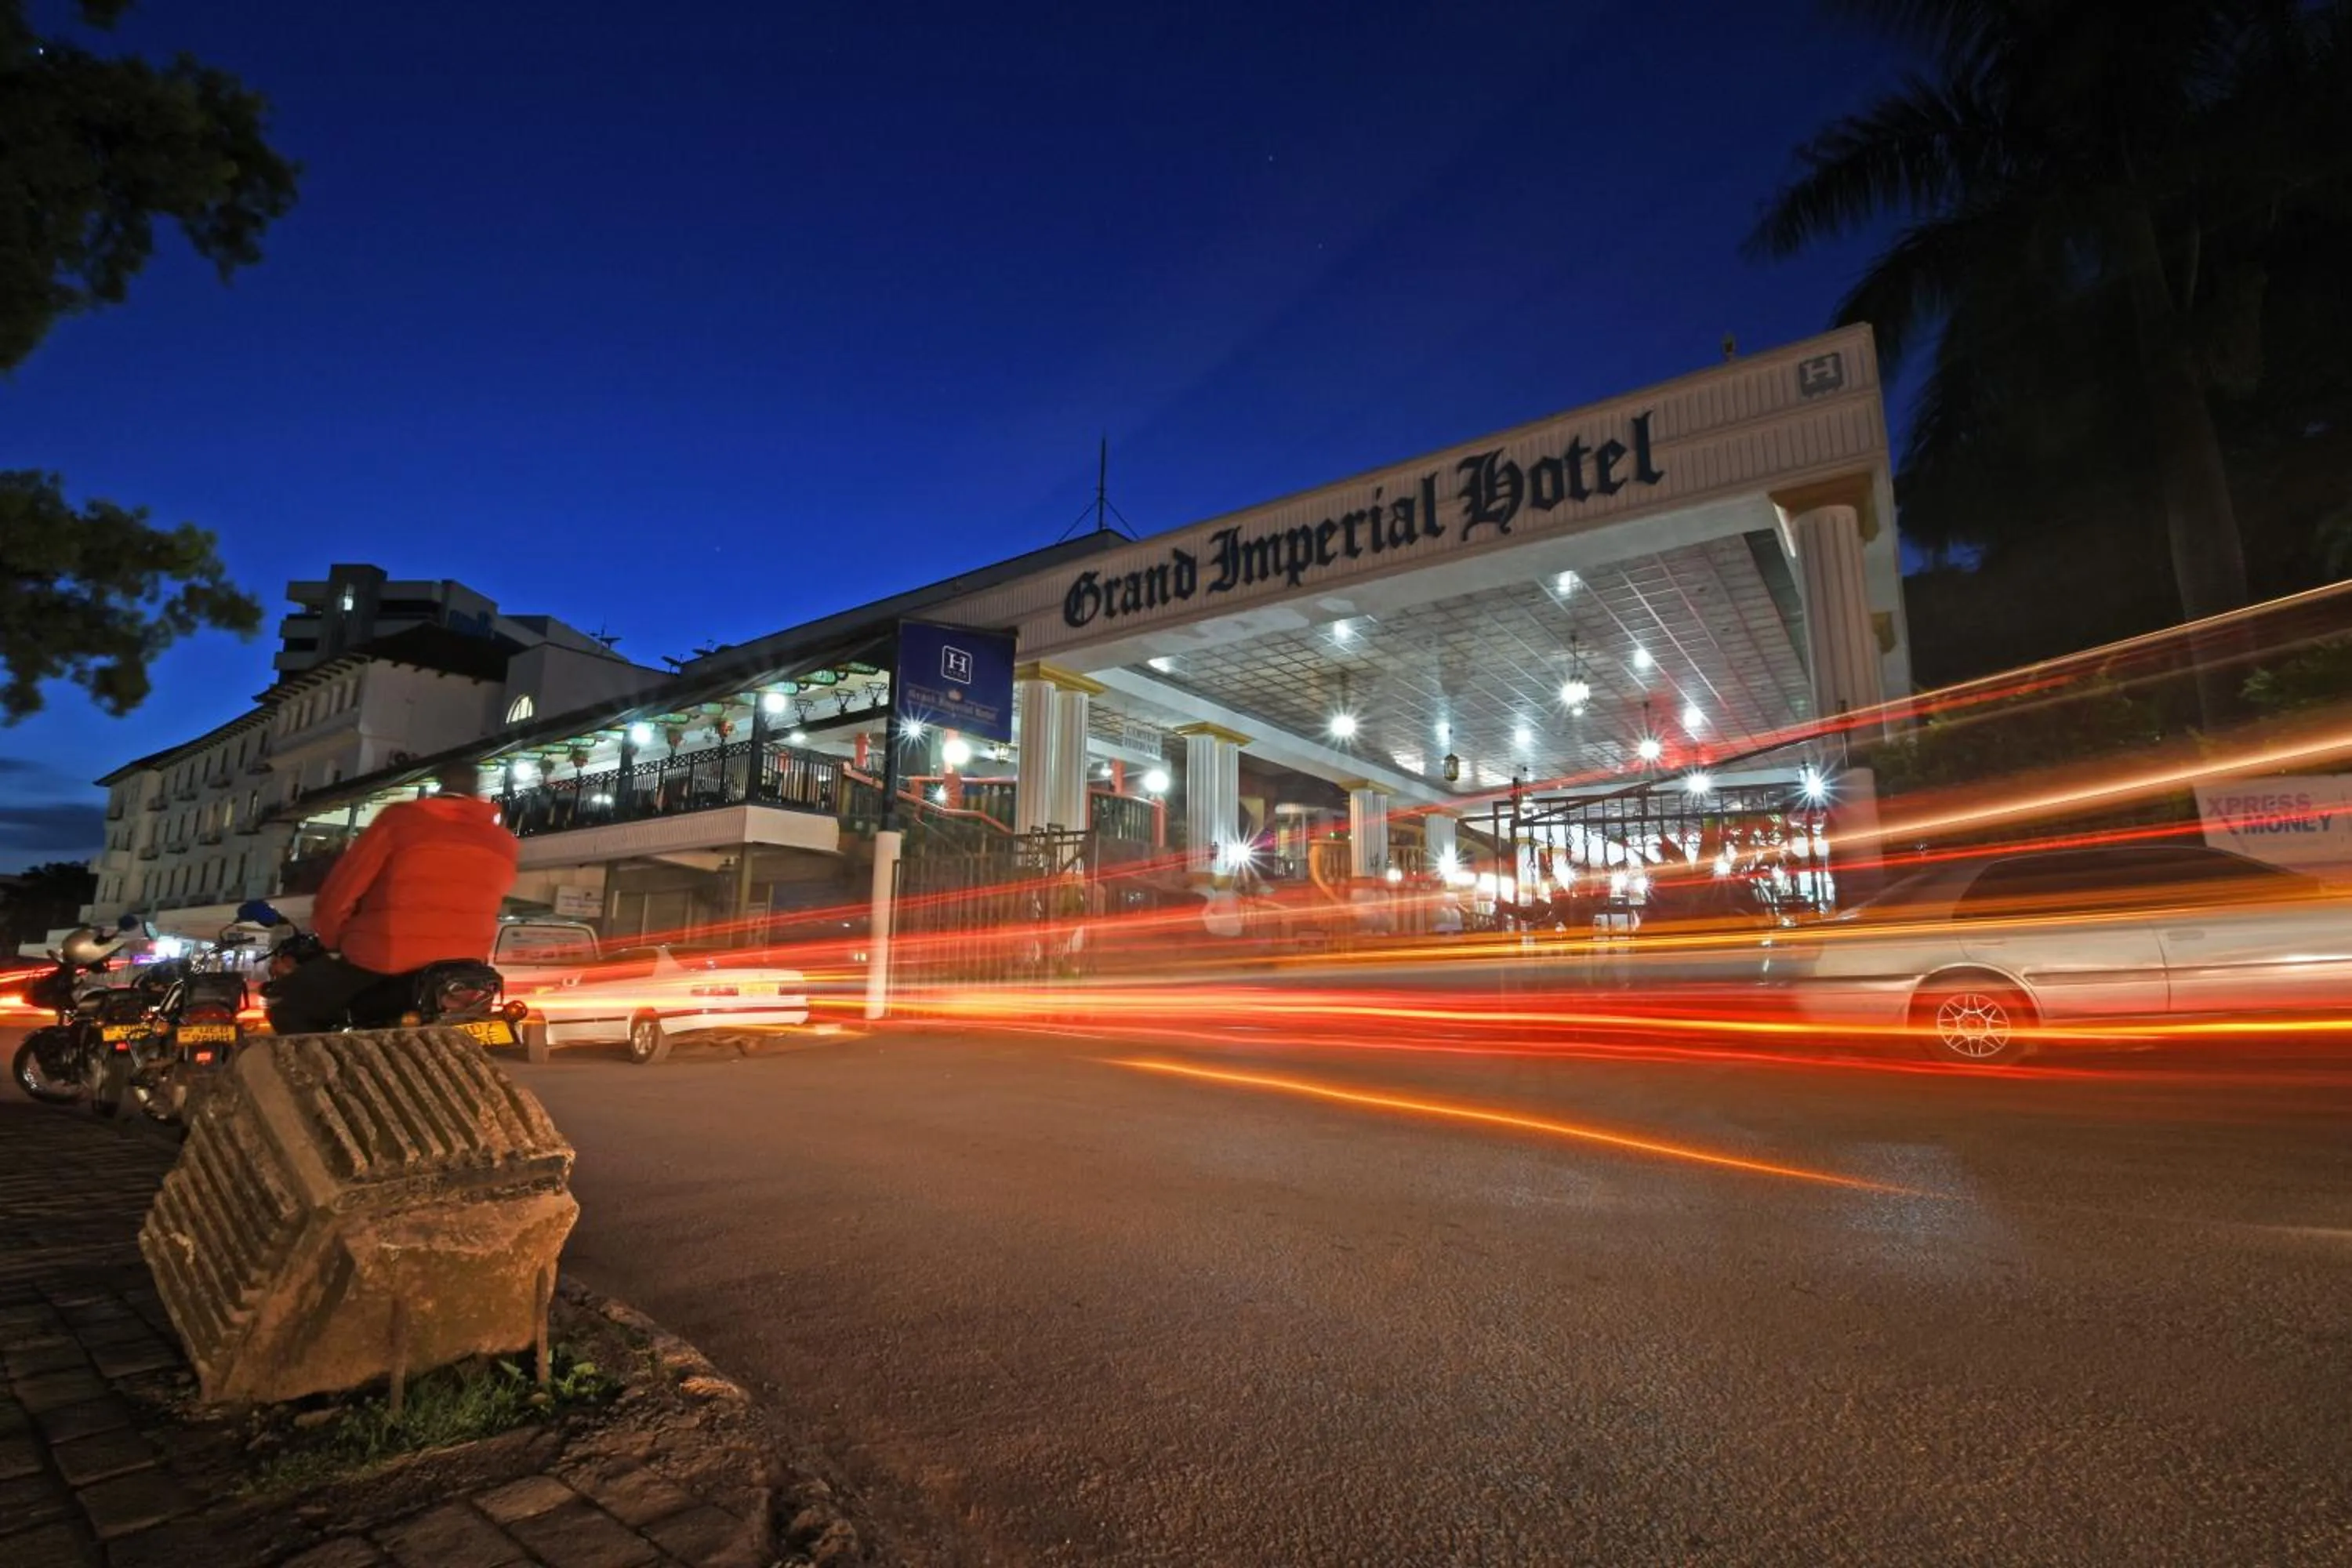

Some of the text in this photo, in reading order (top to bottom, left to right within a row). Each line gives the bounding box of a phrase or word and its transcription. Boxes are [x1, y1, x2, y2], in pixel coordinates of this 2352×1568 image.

[1064, 409, 1664, 628] Grand Imperial Hotel
[2205, 793, 2312, 817] XPRESS
[2243, 812, 2332, 835] MONEY
